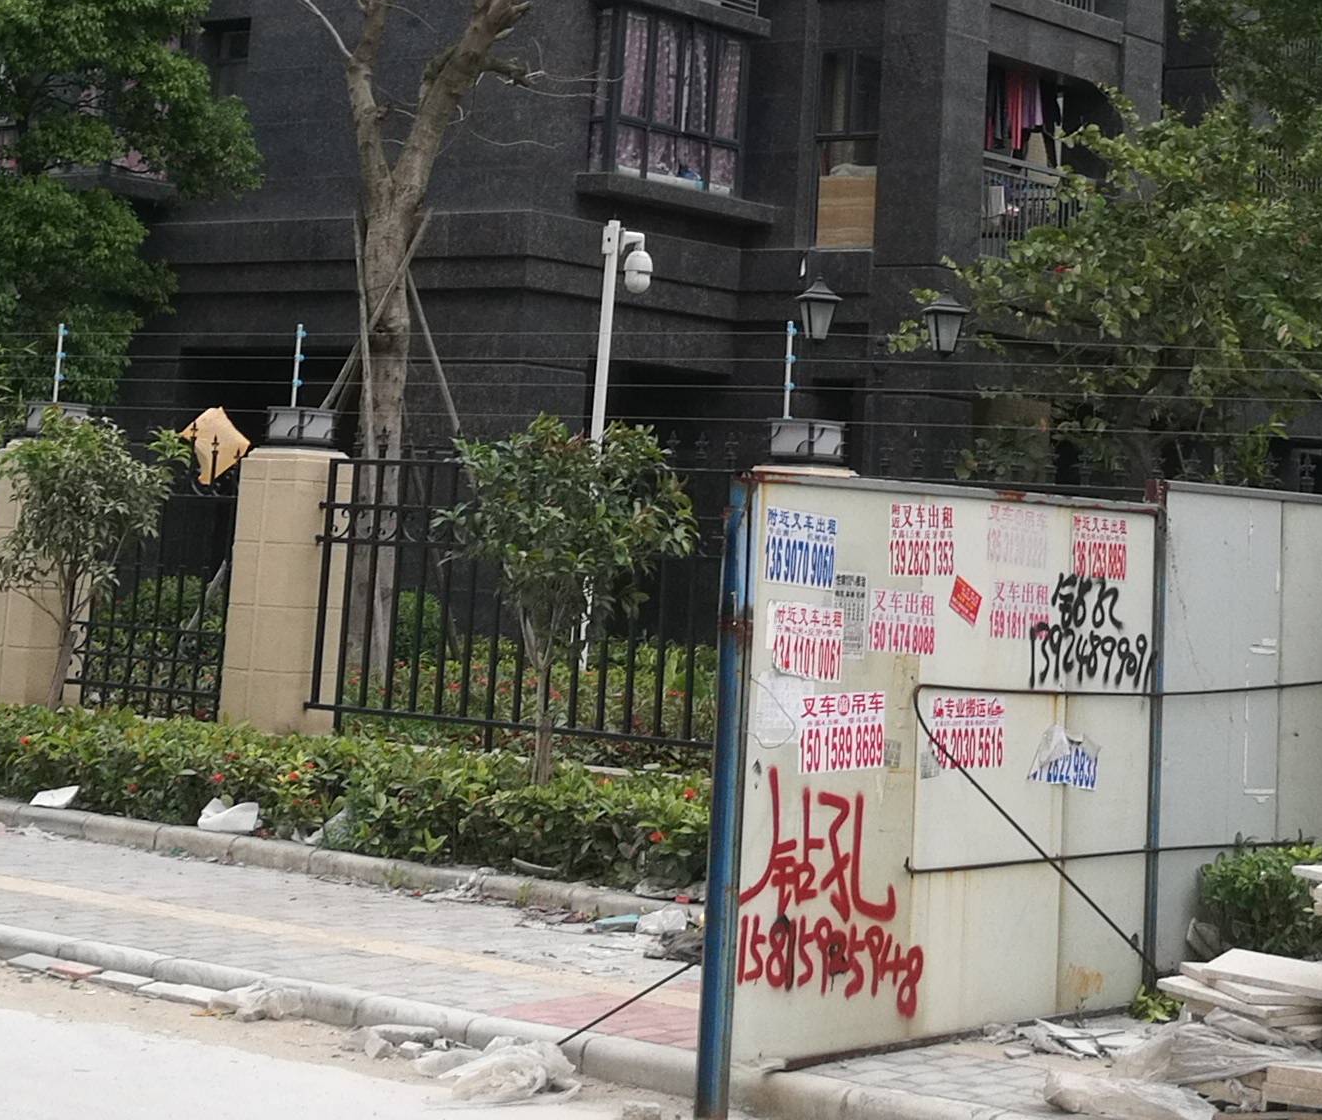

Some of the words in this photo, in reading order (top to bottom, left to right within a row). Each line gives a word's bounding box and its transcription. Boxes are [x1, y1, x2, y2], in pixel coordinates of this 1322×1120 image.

[766, 508, 837, 536] 附近叉车出租
[1073, 514, 1127, 535] 附近叉车出租
[765, 535, 782, 582] 136
[784, 538, 809, 585] 9070
[811, 542, 835, 588] 9060
[889, 540, 905, 576] 139
[908, 540, 930, 576] 2826
[933, 540, 955, 576] 1353
[872, 590, 935, 617] 叉车出租
[992, 581, 1048, 605] 叉车出租
[774, 605, 843, 628] 附近叉车出租
[869, 620, 885, 651] 150
[888, 622, 910, 653] 1474
[794, 636, 816, 678] 1101
[818, 638, 842, 681] 0061
[944, 697, 987, 718] 专业搬运
[800, 728, 821, 774] 150
[825, 725, 853, 772] 1589
[855, 723, 884, 769] 8689
[978, 726, 1004, 769] 5616
